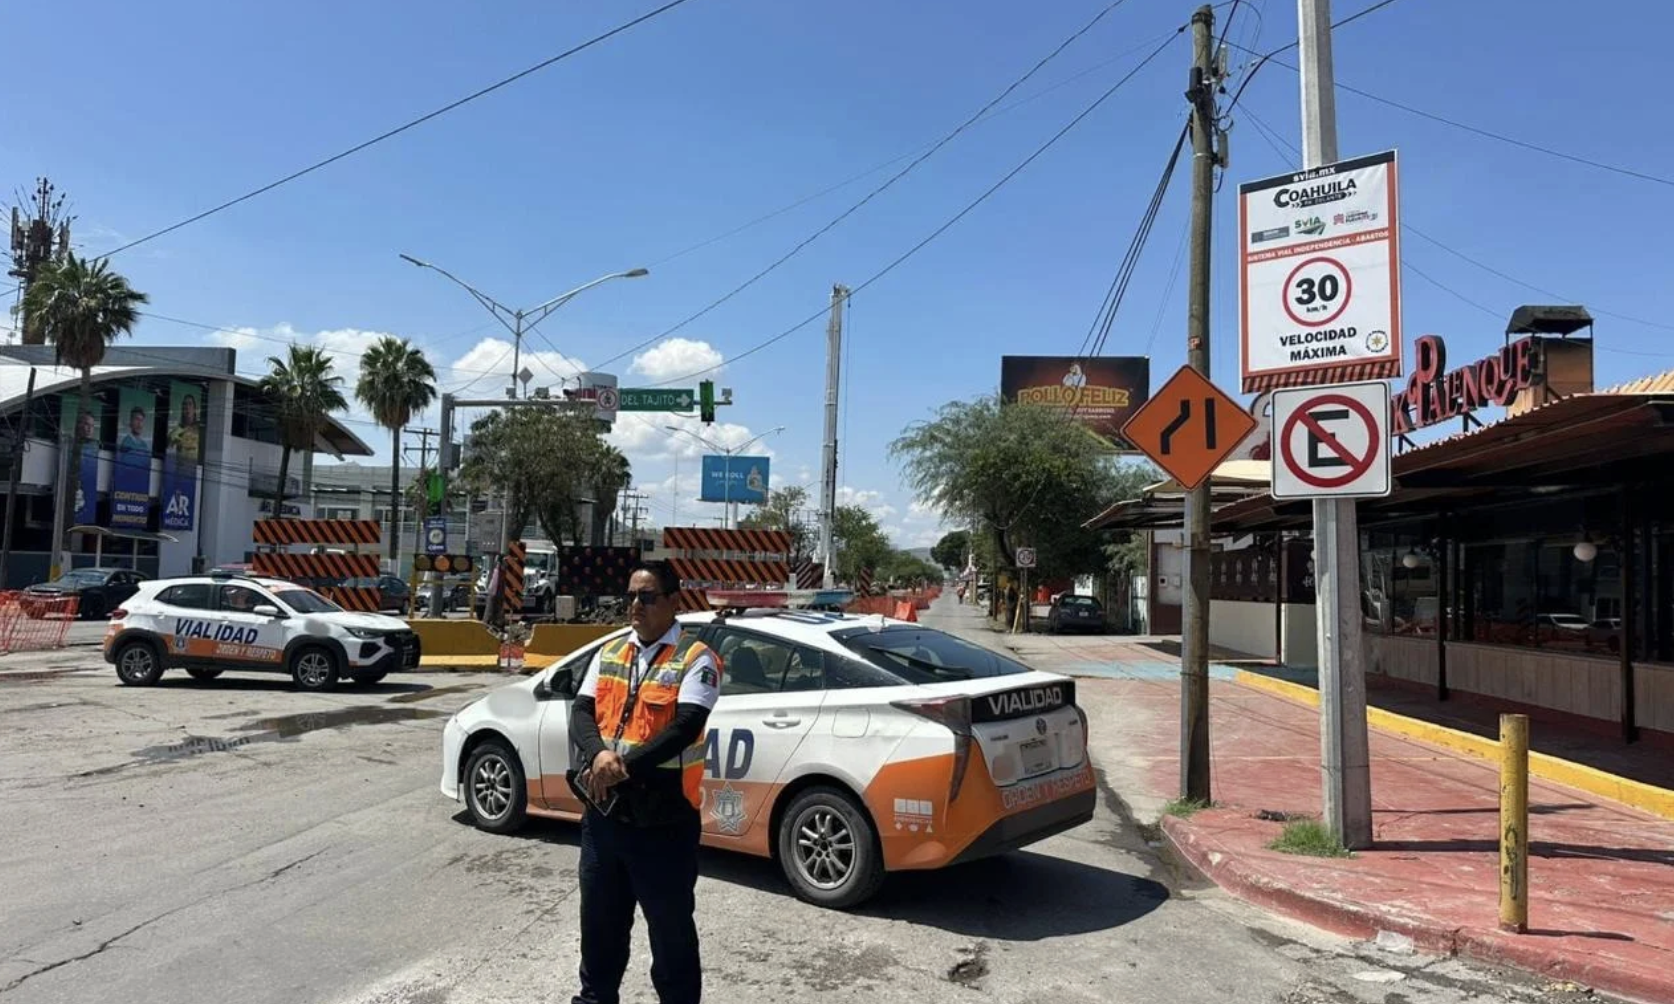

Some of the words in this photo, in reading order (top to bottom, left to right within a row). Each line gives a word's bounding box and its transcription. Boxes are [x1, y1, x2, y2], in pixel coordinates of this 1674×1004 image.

[1293, 166, 1336, 182] svia.mx
[1273, 178, 1357, 208] COAHUILA
[1277, 248, 1293, 257] VIAL
[1293, 238, 1351, 254] INDEPENDENCIA
[1295, 274, 1339, 305] 30
[1306, 303, 1328, 313] km/h
[1280, 326, 1357, 347] VELOCIDAD
[1290, 345, 1347, 362] MÁXIMA
[621, 394, 639, 406] DEL
[643, 394, 676, 406] TAJITO
[1078, 385, 1130, 407] FELIZ
[1308, 409, 1351, 468] E
[166, 494, 189, 516] AR
[176, 618, 258, 645] VIALIDAD
[248, 646, 277, 659] RESPETO
[988, 686, 1062, 715] VIALIDAD
